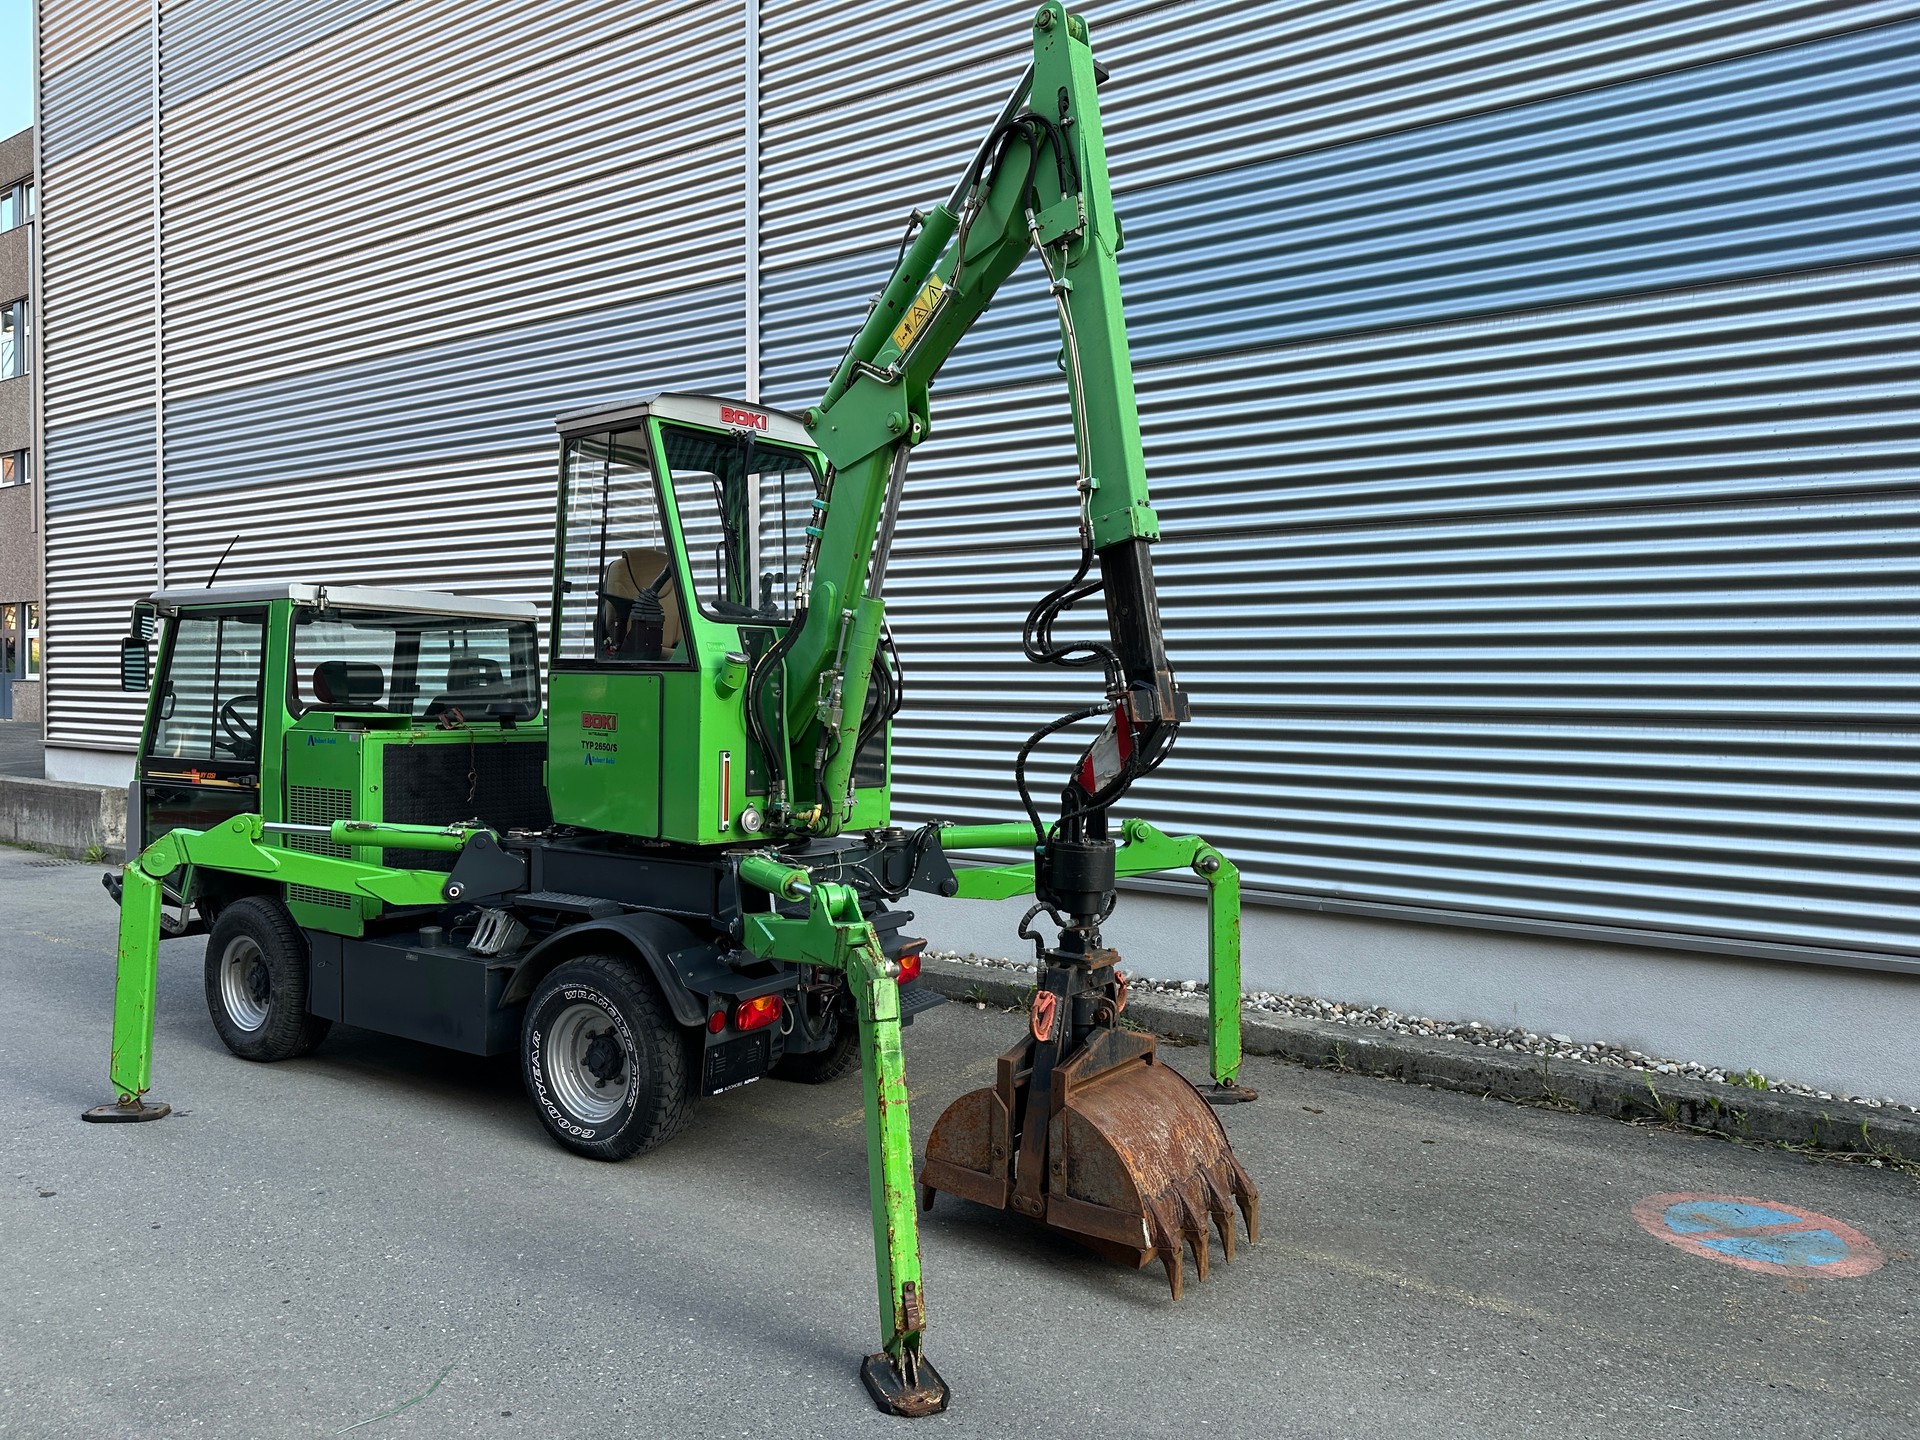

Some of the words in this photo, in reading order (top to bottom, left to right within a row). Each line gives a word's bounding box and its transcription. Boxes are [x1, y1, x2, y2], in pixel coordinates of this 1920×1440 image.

[721, 406, 767, 431] BOKI
[582, 713, 617, 730] BOKI
[581, 740, 594, 749] TYP
[595, 742, 617, 752] 2650/S
[564, 989, 633, 1052] WRANGLER
[531, 1030, 595, 1139] GOODYEAR
